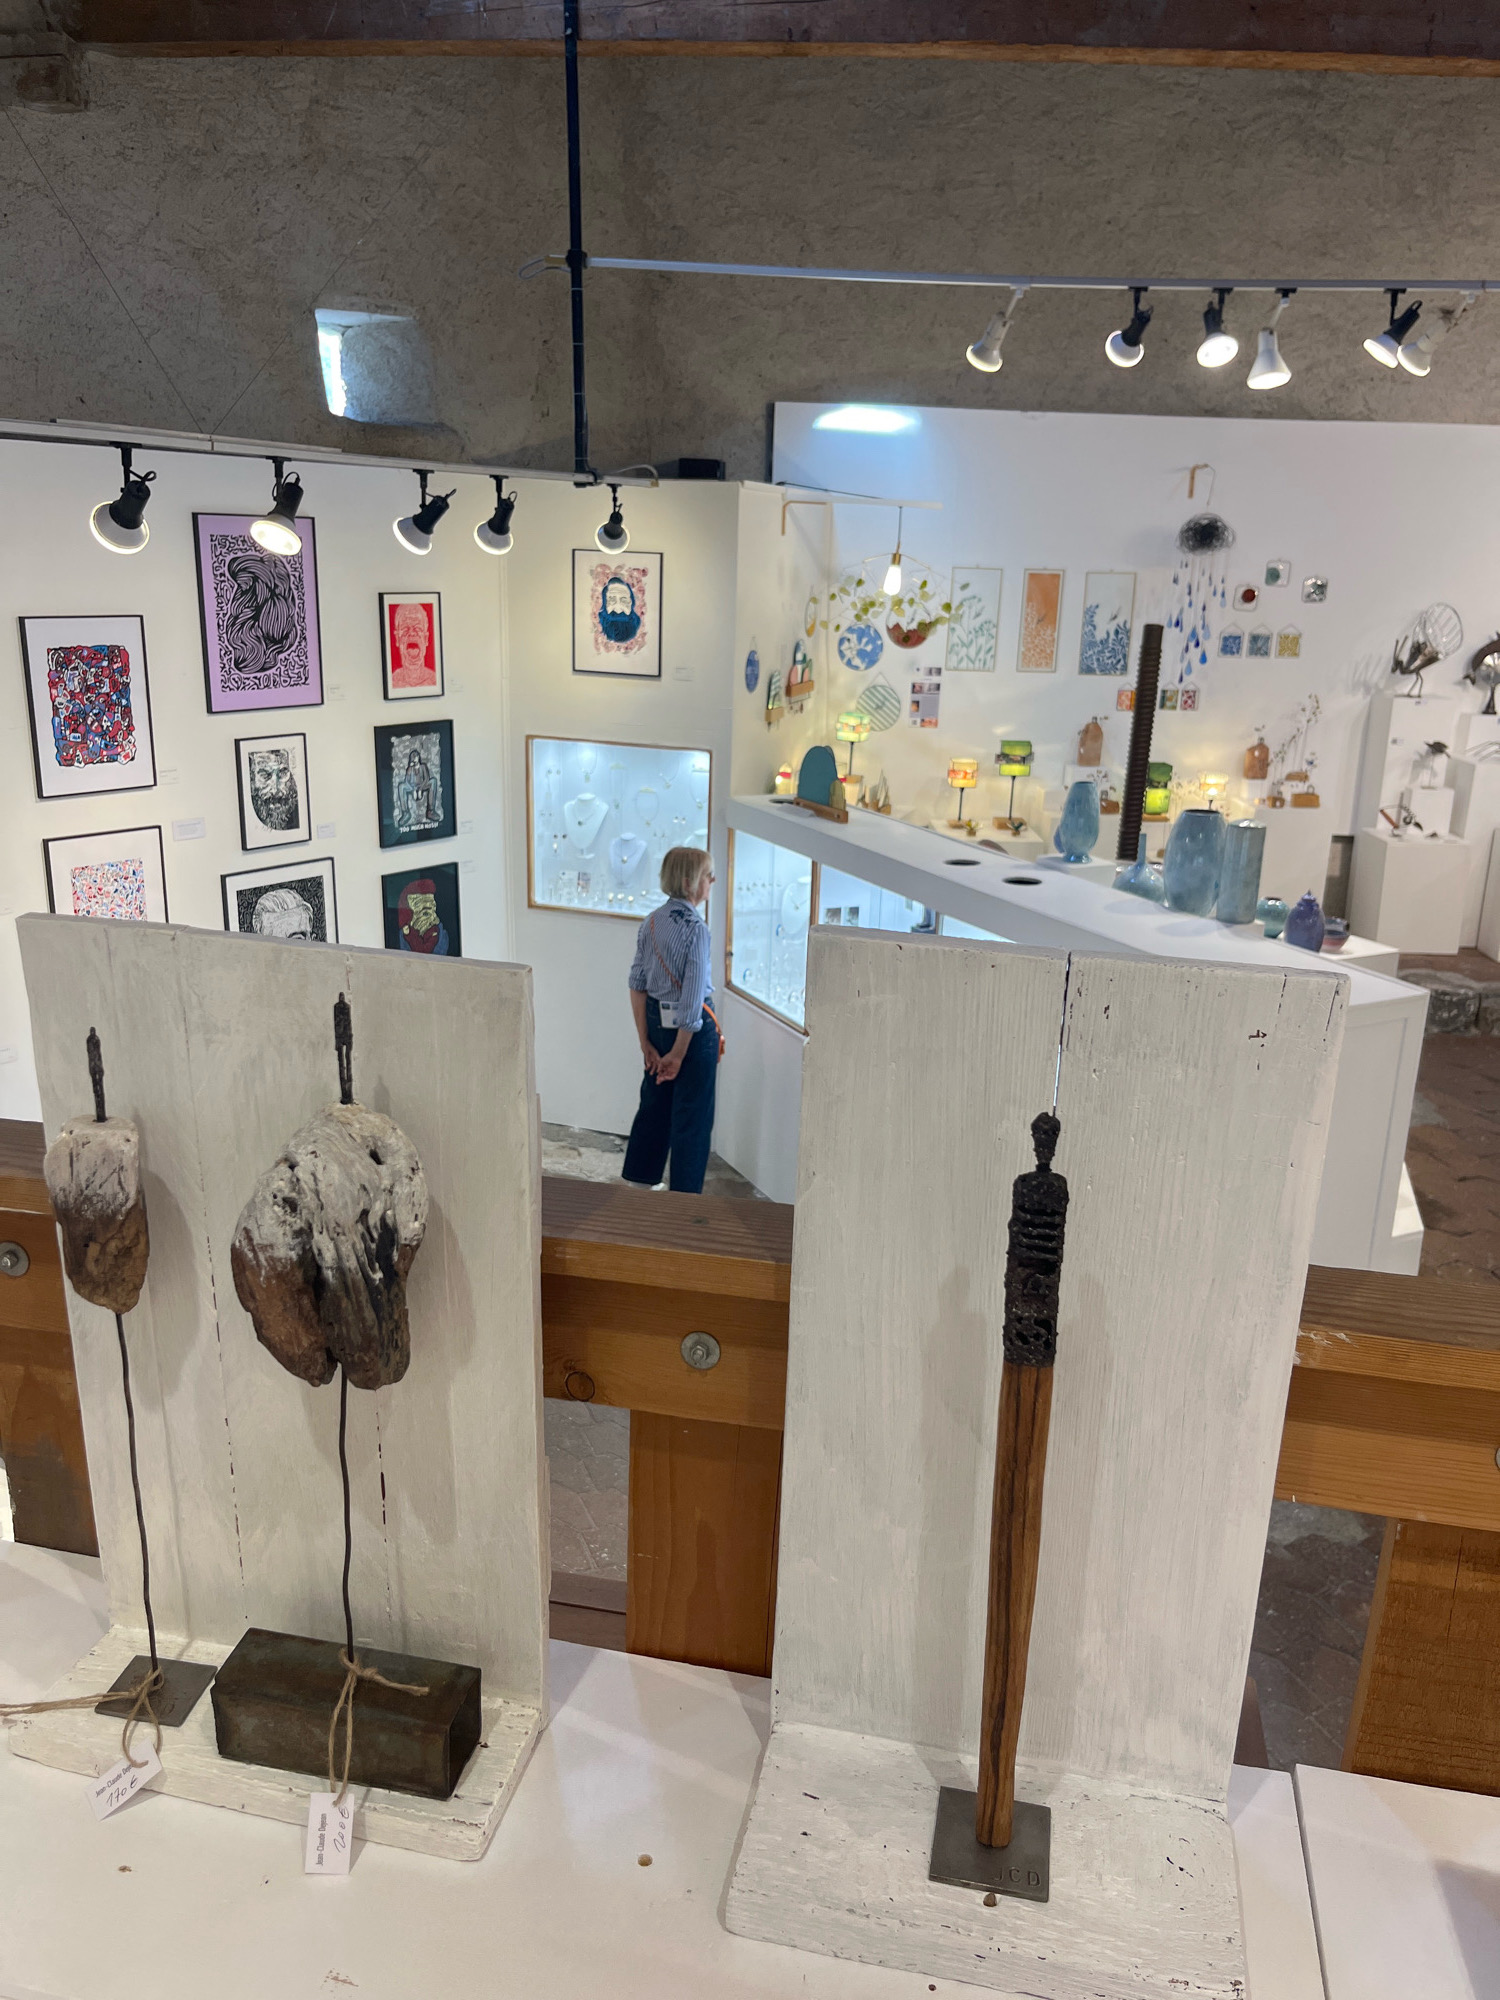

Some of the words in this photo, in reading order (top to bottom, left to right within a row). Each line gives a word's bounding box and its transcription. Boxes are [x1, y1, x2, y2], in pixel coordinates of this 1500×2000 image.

[95, 1773, 122, 1798] Jean-Claude
[106, 1787, 127, 1807] 170
[318, 1813, 328, 1832] Dejean
[316, 1832, 326, 1867] Jean-Claude
